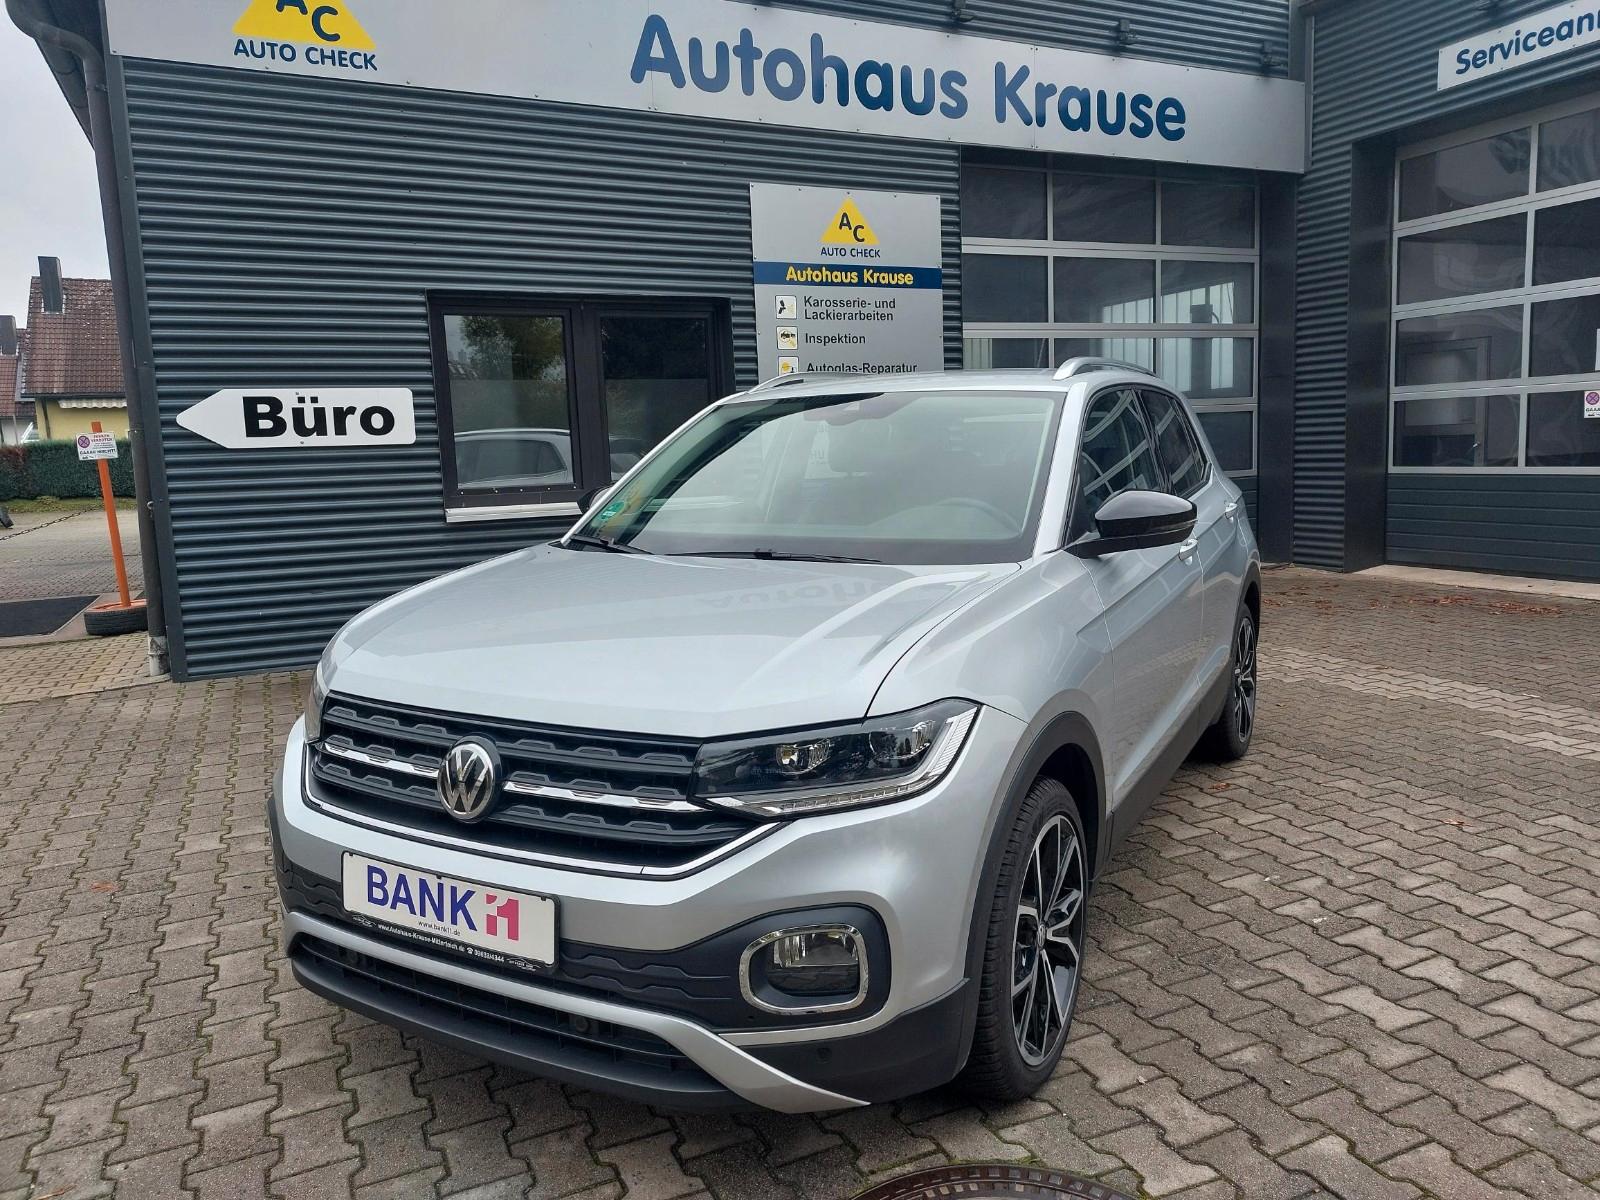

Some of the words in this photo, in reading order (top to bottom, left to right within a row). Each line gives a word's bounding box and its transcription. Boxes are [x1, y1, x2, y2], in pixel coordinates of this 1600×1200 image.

[1455, 9, 1600, 75] Servicean
[233, 38, 297, 62] AUTO
[304, 46, 378, 71] CHECK
[630, 14, 968, 120] Autohaus
[994, 61, 1187, 142] Krause
[820, 246, 847, 257] AUTO
[849, 247, 881, 259] CHECK
[785, 266, 859, 284] Autohaus
[863, 269, 914, 285] Krause
[803, 296, 871, 309] Karosserie-
[874, 298, 896, 309] und
[804, 309, 894, 321] Lackierarbeiten
[805, 332, 866, 346] Inspektion
[806, 362, 918, 374] Autoglas-Reparatur
[242, 396, 395, 438] Büro
[367, 864, 478, 932] BANK
